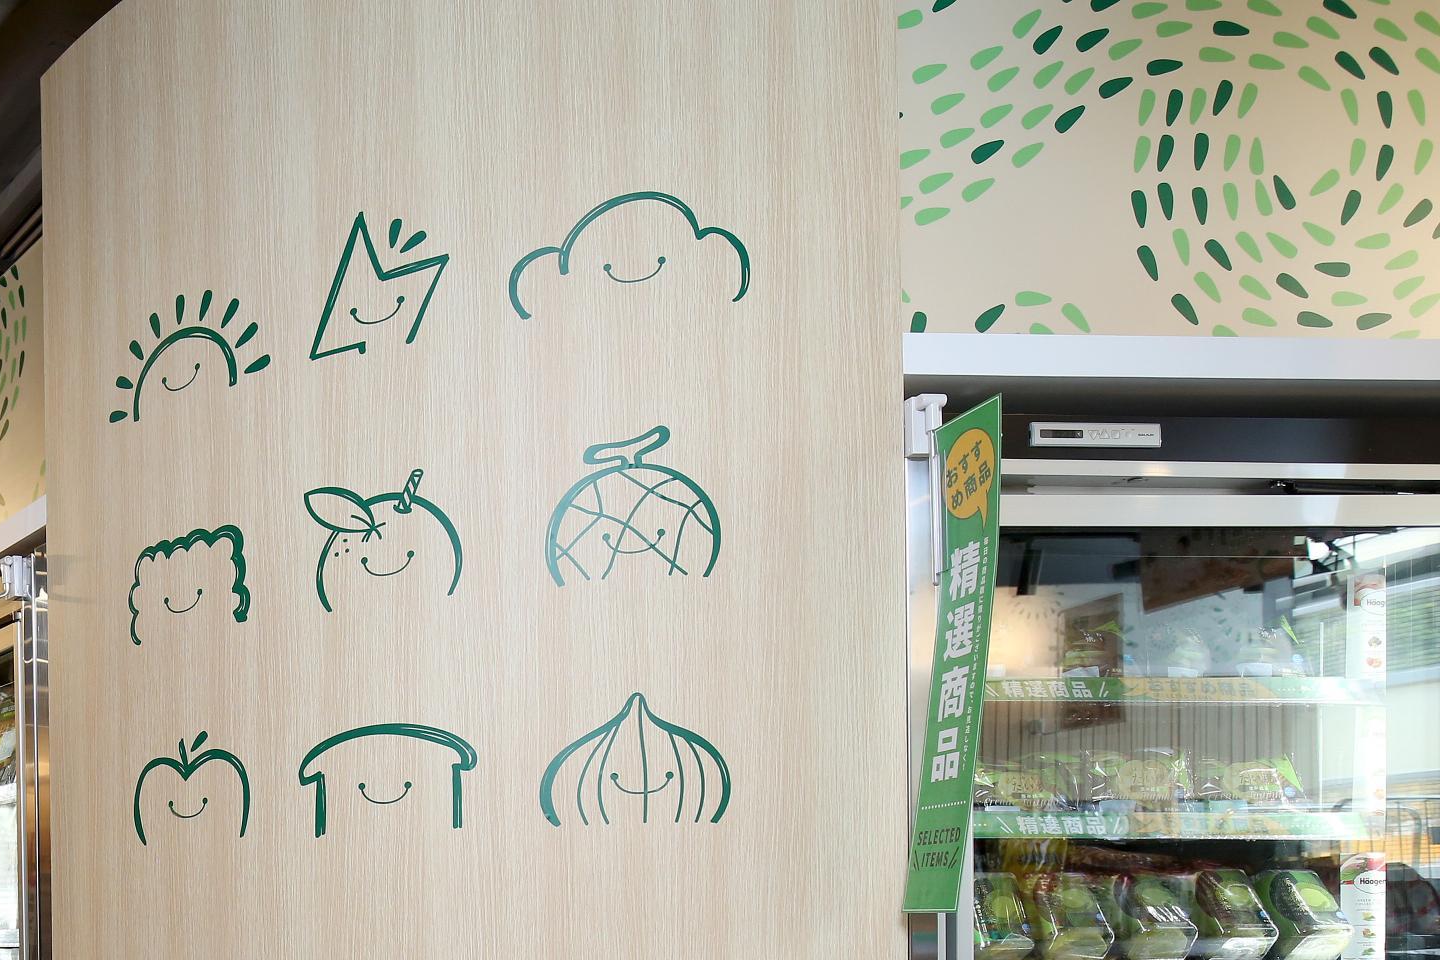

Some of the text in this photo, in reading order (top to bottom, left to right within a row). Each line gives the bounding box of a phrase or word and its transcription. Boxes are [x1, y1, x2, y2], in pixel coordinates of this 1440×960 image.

[931, 541, 980, 783] 精選商品
[1002, 680, 1093, 699] 精選商品
[1017, 815, 1107, 835] 精選商品
[917, 827, 961, 846] SELECTED
[921, 851, 950, 868] ITEMS
